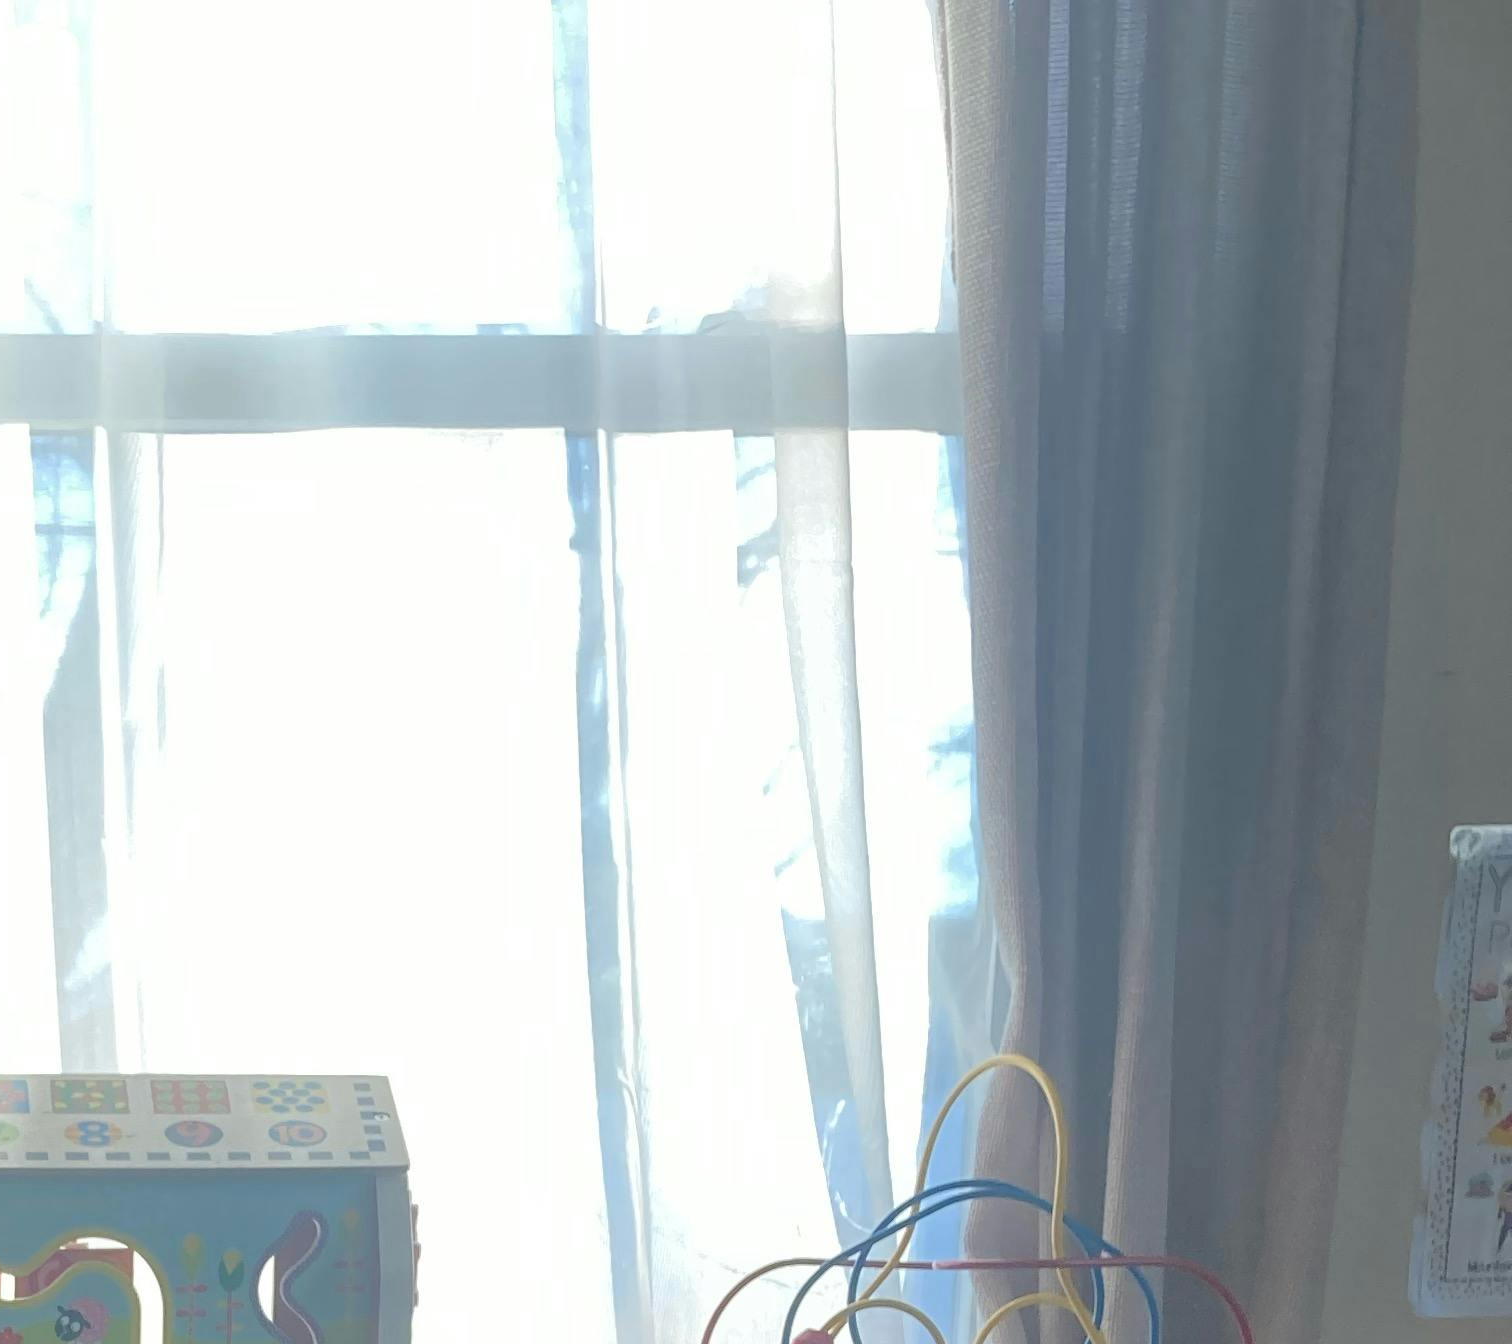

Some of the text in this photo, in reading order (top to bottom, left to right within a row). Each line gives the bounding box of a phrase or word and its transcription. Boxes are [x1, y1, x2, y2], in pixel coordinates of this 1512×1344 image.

[78, 1120, 111, 1146] 8
[178, 1120, 212, 1146] 9
[279, 1120, 326, 1146] 10
